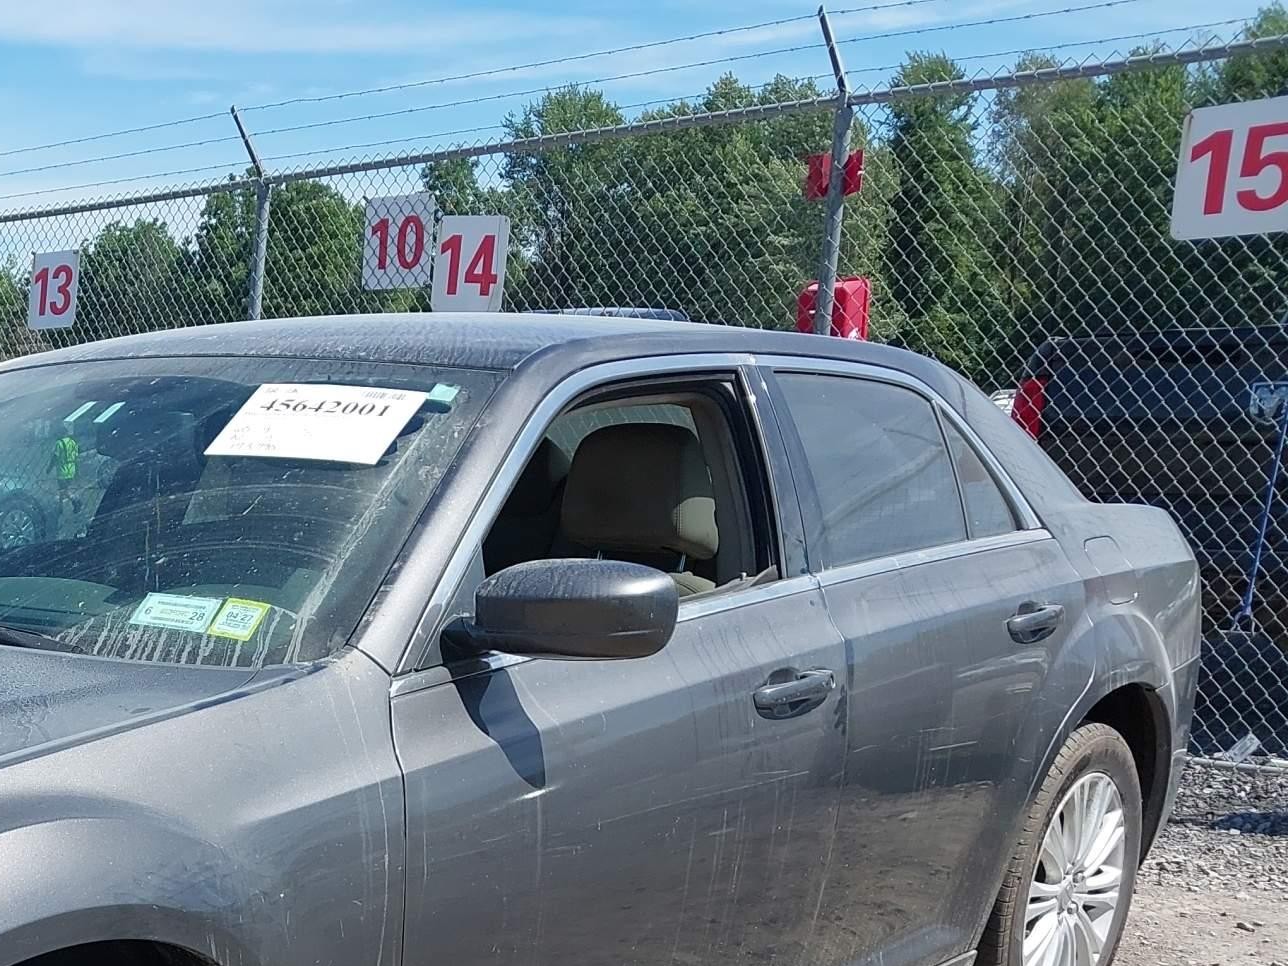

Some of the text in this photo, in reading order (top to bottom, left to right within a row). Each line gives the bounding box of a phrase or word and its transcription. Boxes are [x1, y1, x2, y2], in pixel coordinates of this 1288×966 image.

[1190, 121, 1288, 217] 15
[372, 215, 425, 270] 10
[440, 234, 498, 296] 14
[34, 264, 73, 316] 13
[260, 399, 392, 417] 45642001
[144, 606, 154, 615] 6
[189, 611, 206, 622] 28
